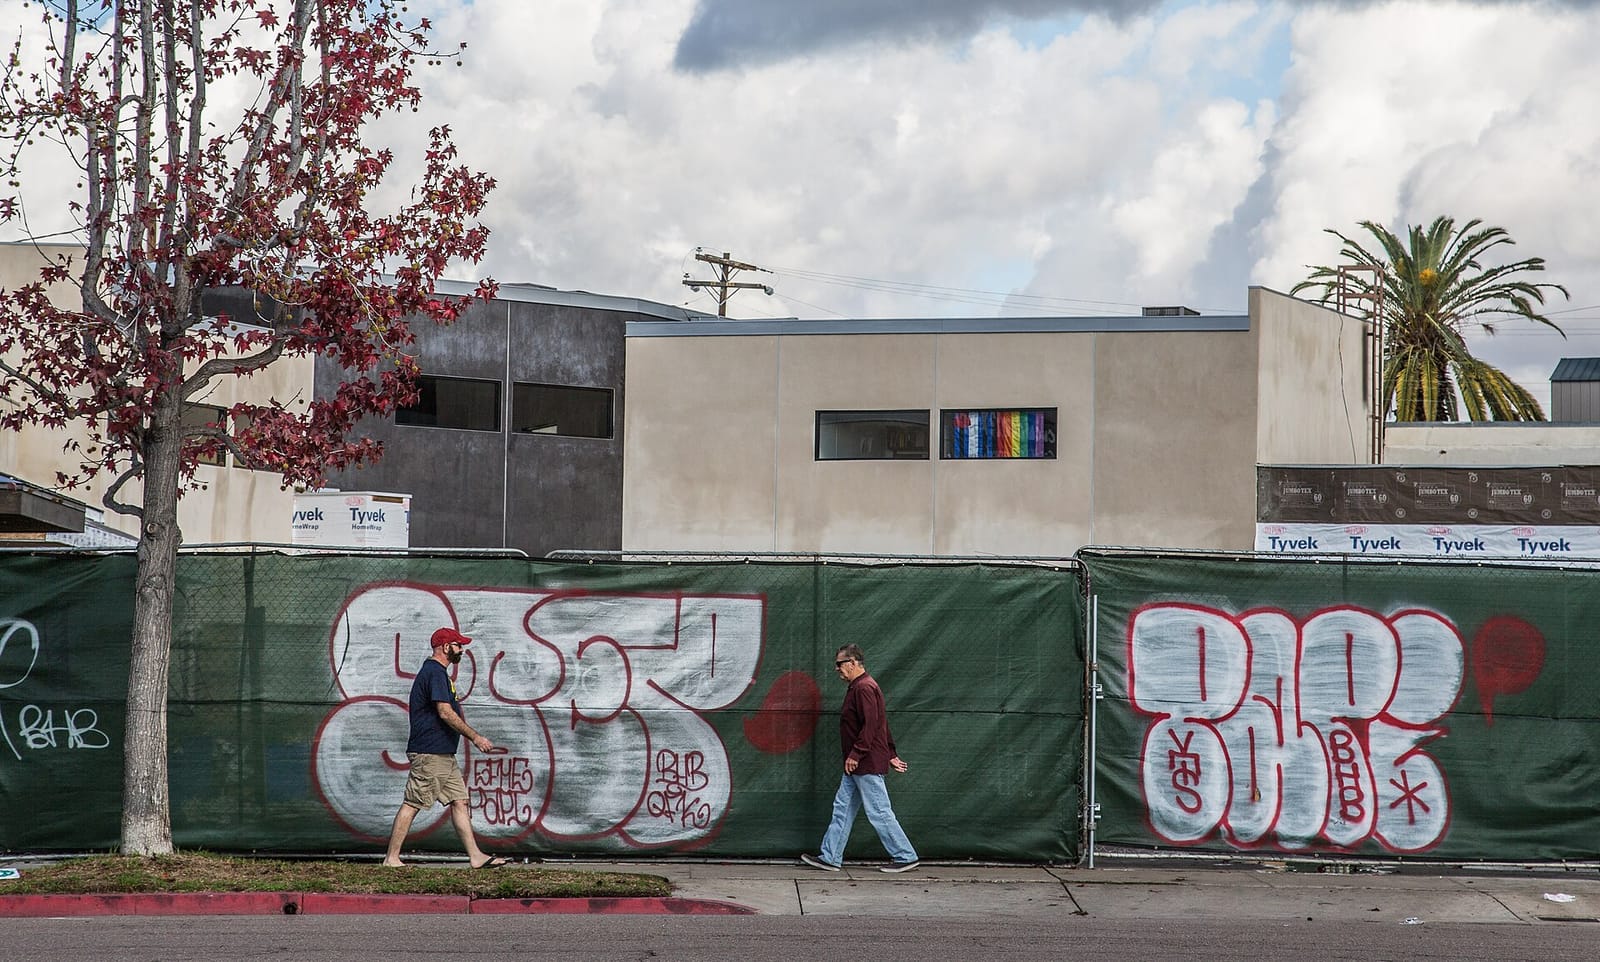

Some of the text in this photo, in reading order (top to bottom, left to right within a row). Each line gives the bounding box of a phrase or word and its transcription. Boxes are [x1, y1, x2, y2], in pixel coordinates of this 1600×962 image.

[349, 507, 385, 524] Tyvek
[1268, 536, 1318, 552] Tyvek
[1350, 536, 1401, 552] Tyvek
[1433, 537, 1485, 553] Tyvek
[1517, 538, 1571, 554] Tyvek
